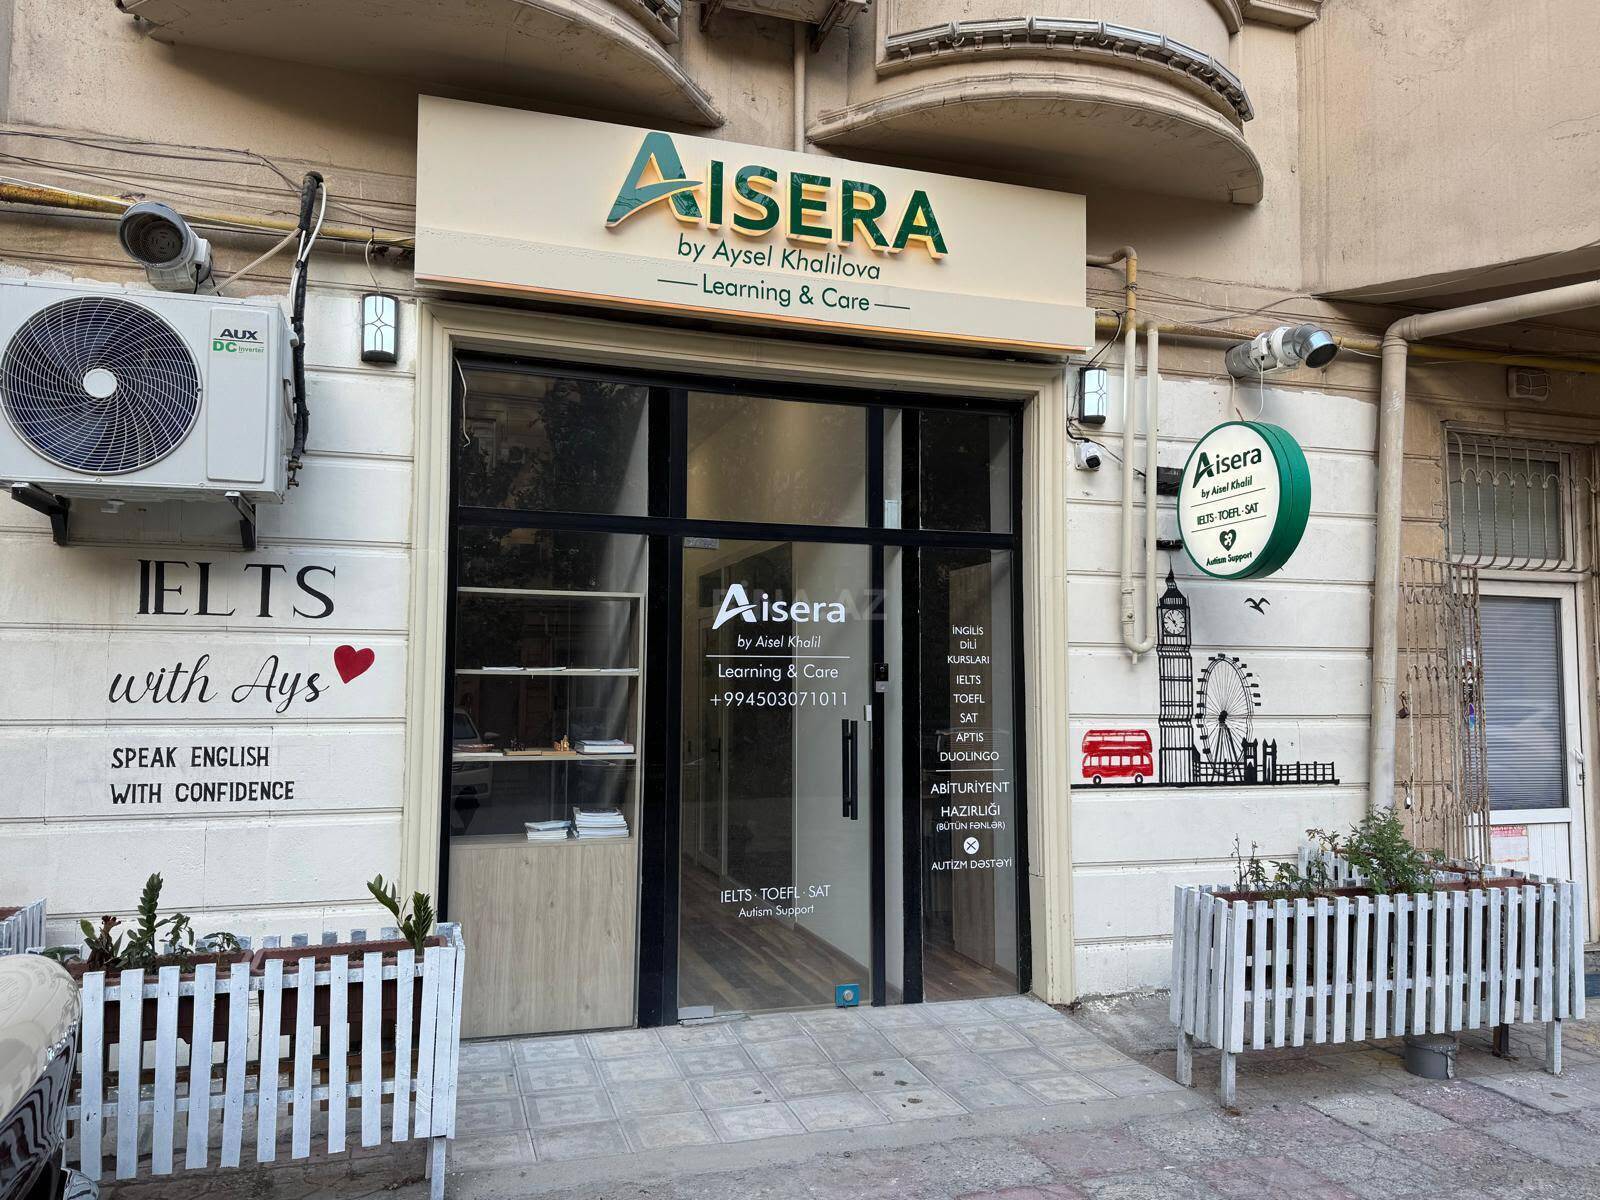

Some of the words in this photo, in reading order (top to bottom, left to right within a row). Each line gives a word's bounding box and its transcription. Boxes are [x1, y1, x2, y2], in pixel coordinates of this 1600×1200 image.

[605, 132, 949, 259] AISERA
[677, 232, 706, 261] by
[711, 239, 773, 267] Aysel
[781, 248, 881, 280] Khalilova
[703, 273, 791, 307] Learning
[798, 286, 814, 305] &
[821, 287, 870, 311] Care
[219, 328, 258, 340] AUX
[212, 340, 237, 352] DC
[1192, 448, 1262, 489] Aisera
[1201, 488, 1210, 499] by
[1211, 482, 1229, 496] Aisel
[1231, 475, 1253, 491] Khalil
[1197, 513, 1215, 526] IELTS
[1218, 507, 1241, 521] TOEFL
[1245, 502, 1259, 515] SAT
[1206, 557, 1226, 566] Autism
[1228, 551, 1252, 563] Support
[136, 559, 336, 619] IELTS
[712, 583, 846, 630] Aisera
[737, 635, 752, 650] by
[755, 635, 784, 648] Aisel
[787, 635, 821, 648] Khalil
[959, 639, 977, 650] DİLİ
[947, 655, 990, 664] KURSLARI
[718, 664, 781, 682] Learning
[787, 664, 798, 678] &
[803, 664, 839, 679] Care
[956, 675, 981, 685] IELTS
[108, 653, 218, 704] with
[231, 654, 330, 714] Ays
[710, 691, 847, 707] +994503071011
[953, 694, 985, 704] TOEFL
[959, 712, 978, 723] SAT
[956, 732, 984, 742] APTIS
[111, 746, 178, 769] SPEAK
[191, 746, 270, 767] ENGLISH
[940, 751, 1000, 762] DUOLINGO
[110, 783, 161, 804] WITH
[175, 780, 295, 803] CONFIDENCE
[930, 780, 1010, 794] ABİTURİYENT
[941, 803, 1000, 817] HAZIRLIĞI
[936, 821, 967, 832] (BÜTÜN
[720, 889, 752, 904] IELTS
[760, 886, 800, 900] TOEFL
[808, 884, 831, 898] SAT
[738, 906, 773, 918] Autism
[775, 904, 814, 918] Support
